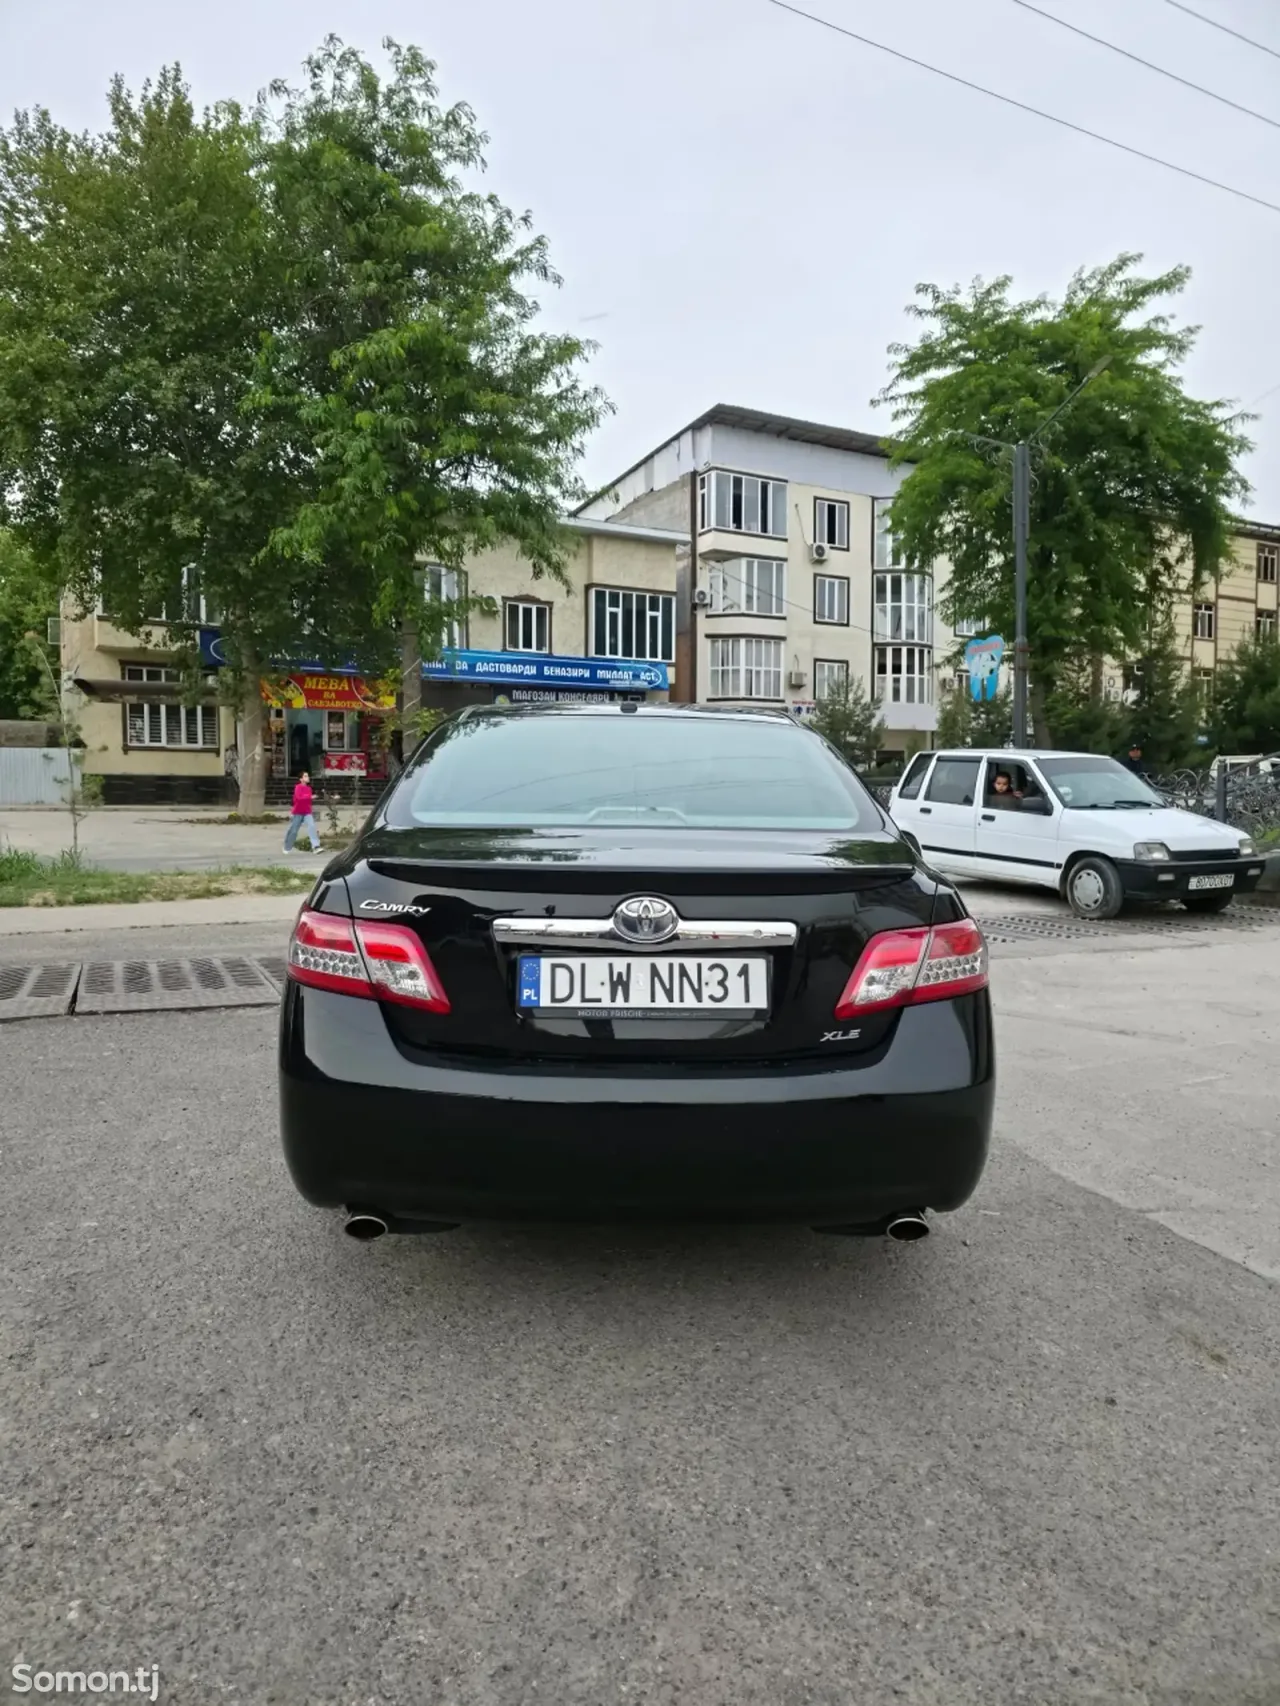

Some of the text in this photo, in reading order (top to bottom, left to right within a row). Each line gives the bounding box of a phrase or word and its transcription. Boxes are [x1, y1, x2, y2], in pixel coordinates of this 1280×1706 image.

[475, 661, 537, 675] ДАСТОВАРДИ
[543, 666, 590, 678] БЕНАЗИРИ
[597, 669, 633, 680] МИЛЛАТ
[303, 676, 349, 690] МЕВА
[359, 899, 432, 917] CAMRY
[550, 962, 751, 1004] DLW NN31
[523, 989, 538, 1000] PL
[820, 1028, 861, 1042] XLE
